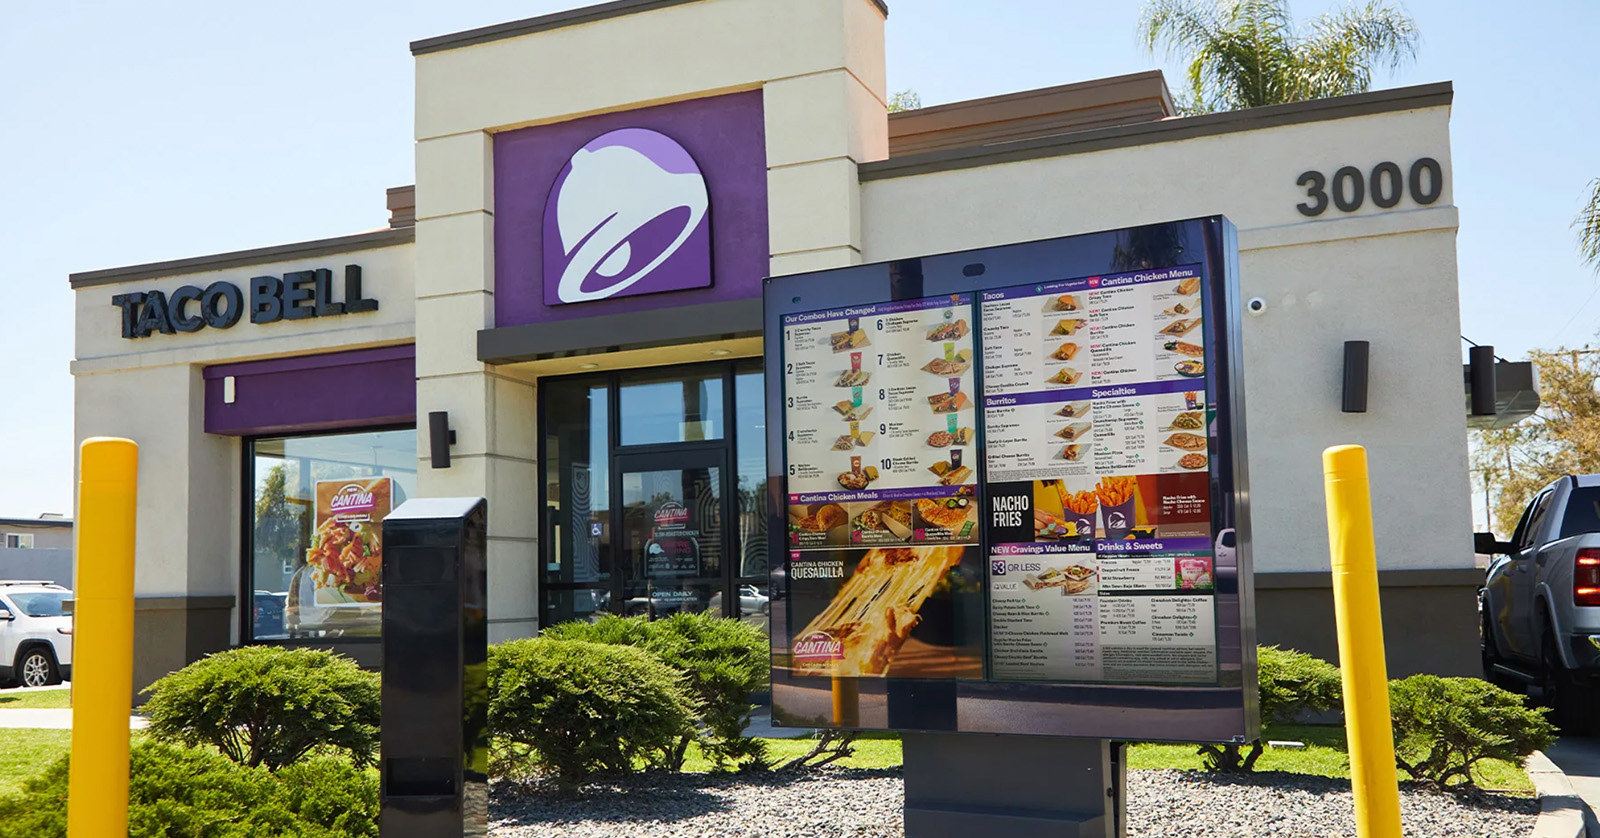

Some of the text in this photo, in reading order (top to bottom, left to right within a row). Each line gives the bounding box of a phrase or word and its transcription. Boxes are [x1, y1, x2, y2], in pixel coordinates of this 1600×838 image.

[1296, 157, 1443, 217] 3000
[1101, 278, 1132, 286] Cantina
[1134, 273, 1168, 282] Chicken
[1169, 269, 1193, 278] Menu
[112, 264, 379, 339] TACO BELL
[983, 292, 1004, 300] Tacos
[798, 313, 826, 322] Combos
[845, 306, 876, 317] Changed
[877, 319, 883, 331] 6
[786, 330, 791, 340] 1
[878, 354, 884, 365] 7
[787, 363, 793, 374] 2
[879, 388, 885, 400] 8
[1092, 387, 1136, 398] Specialties
[788, 397, 794, 408] 3
[880, 423, 886, 435] 9
[788, 430, 794, 442] 4
[789, 464, 795, 476] 5
[881, 458, 892, 470] 10
[331, 492, 373, 508] CANTINA
[828, 493, 856, 501] Chicken
[857, 492, 878, 500] Meals
[992, 495, 1029, 512] NACHO
[654, 508, 688, 519] CANTINA
[993, 511, 1022, 528] FRIES
[791, 534, 799, 544] 11
[991, 543, 1090, 555] NEW Cravings Value Menu
[1098, 543, 1124, 551] Drinks
[1133, 542, 1163, 550] Sweets
[791, 567, 844, 580] QUESADILLA
[992, 561, 1005, 574] $3
[1020, 563, 1041, 571] LESS
[794, 640, 841, 654] CANTINA
